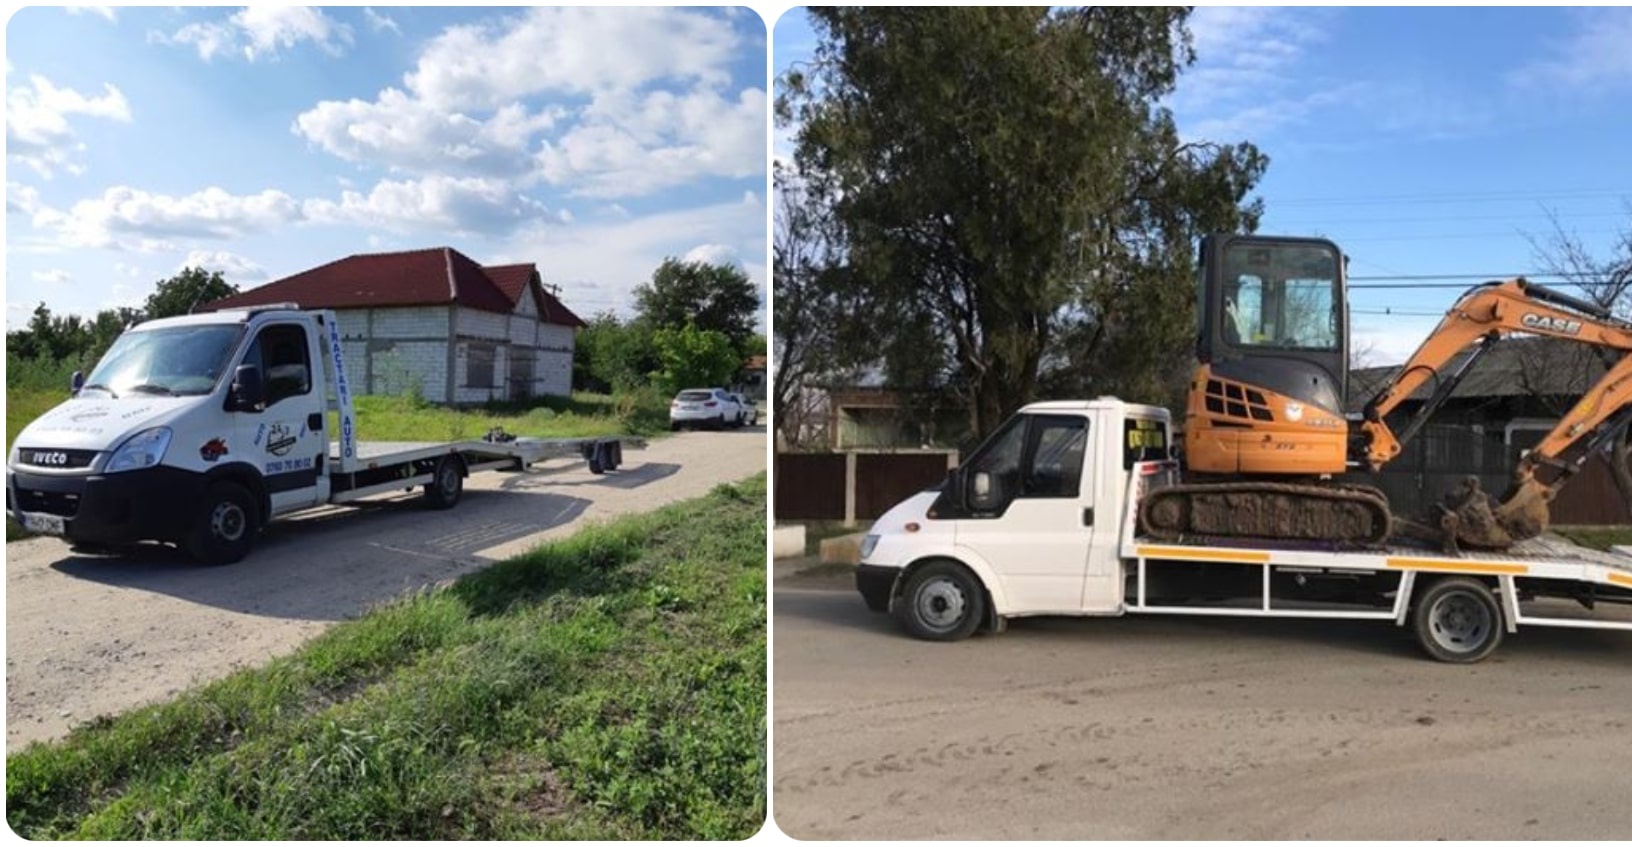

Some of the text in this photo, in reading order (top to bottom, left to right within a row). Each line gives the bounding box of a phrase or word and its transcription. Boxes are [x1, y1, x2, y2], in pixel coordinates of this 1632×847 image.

[1522, 313, 1580, 335] CASE
[329, 321, 352, 458] TRACTARI AUTO
[33, 452, 67, 464] IVECO
